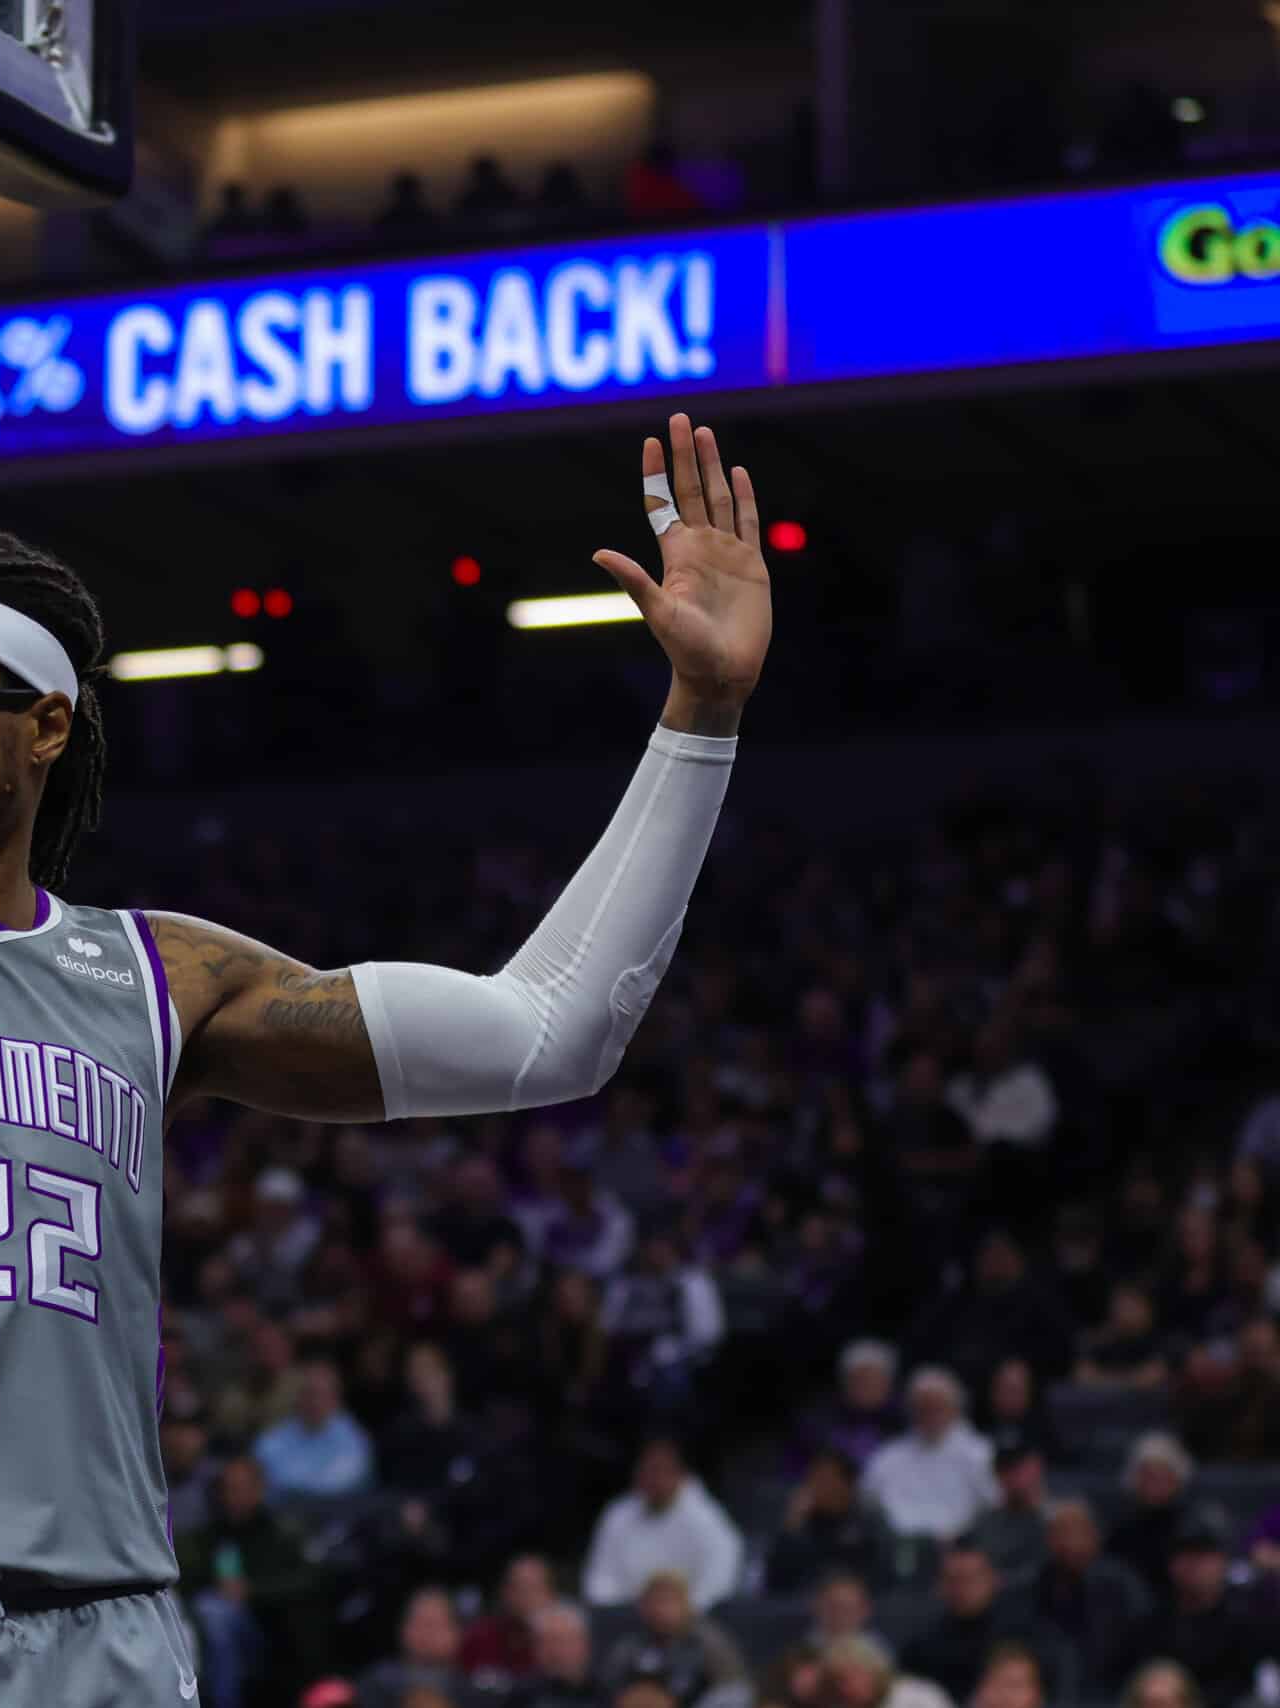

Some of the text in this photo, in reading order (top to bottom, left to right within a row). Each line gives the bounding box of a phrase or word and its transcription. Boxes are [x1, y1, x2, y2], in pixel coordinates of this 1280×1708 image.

[106, 286, 373, 435] CASH
[408, 252, 714, 406] BACK!
[56, 954, 135, 985] dialpad
